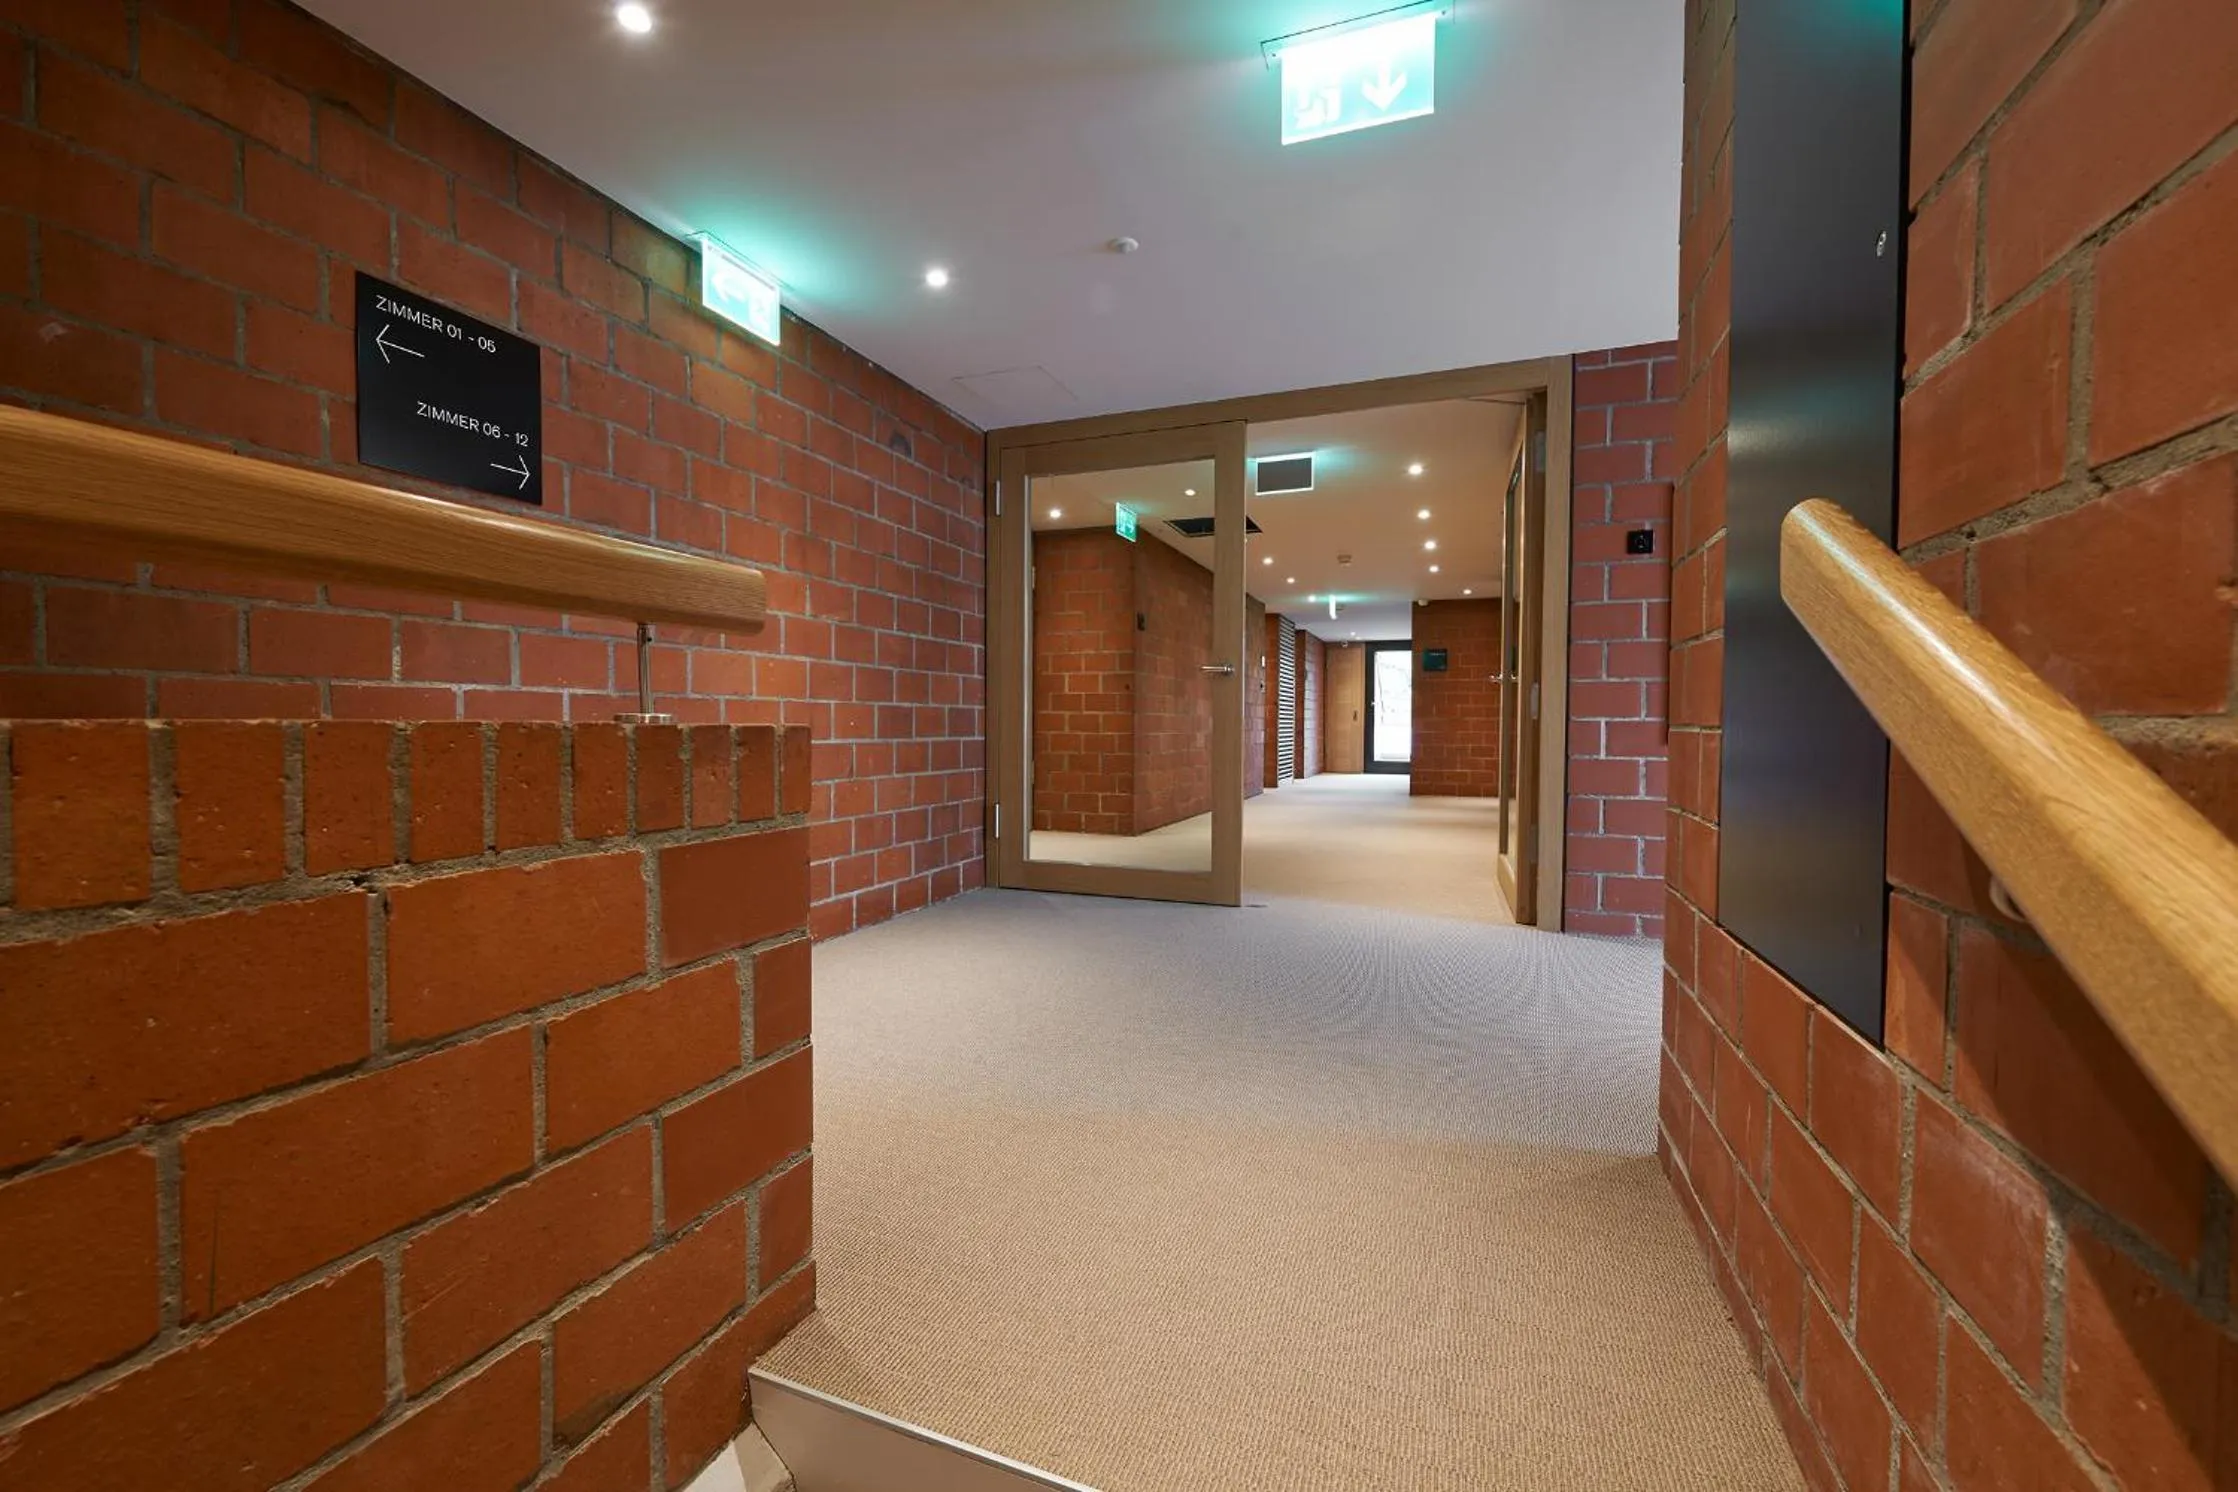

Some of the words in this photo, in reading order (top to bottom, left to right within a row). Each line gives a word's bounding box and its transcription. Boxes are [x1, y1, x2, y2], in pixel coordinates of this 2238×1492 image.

[375, 294, 443, 332] ZIMMER
[447, 324, 462, 341] 01
[478, 336, 496, 353] 05
[416, 401, 480, 432] ZIMMER
[483, 422, 501, 438] 06
[515, 432, 529, 447] 12
